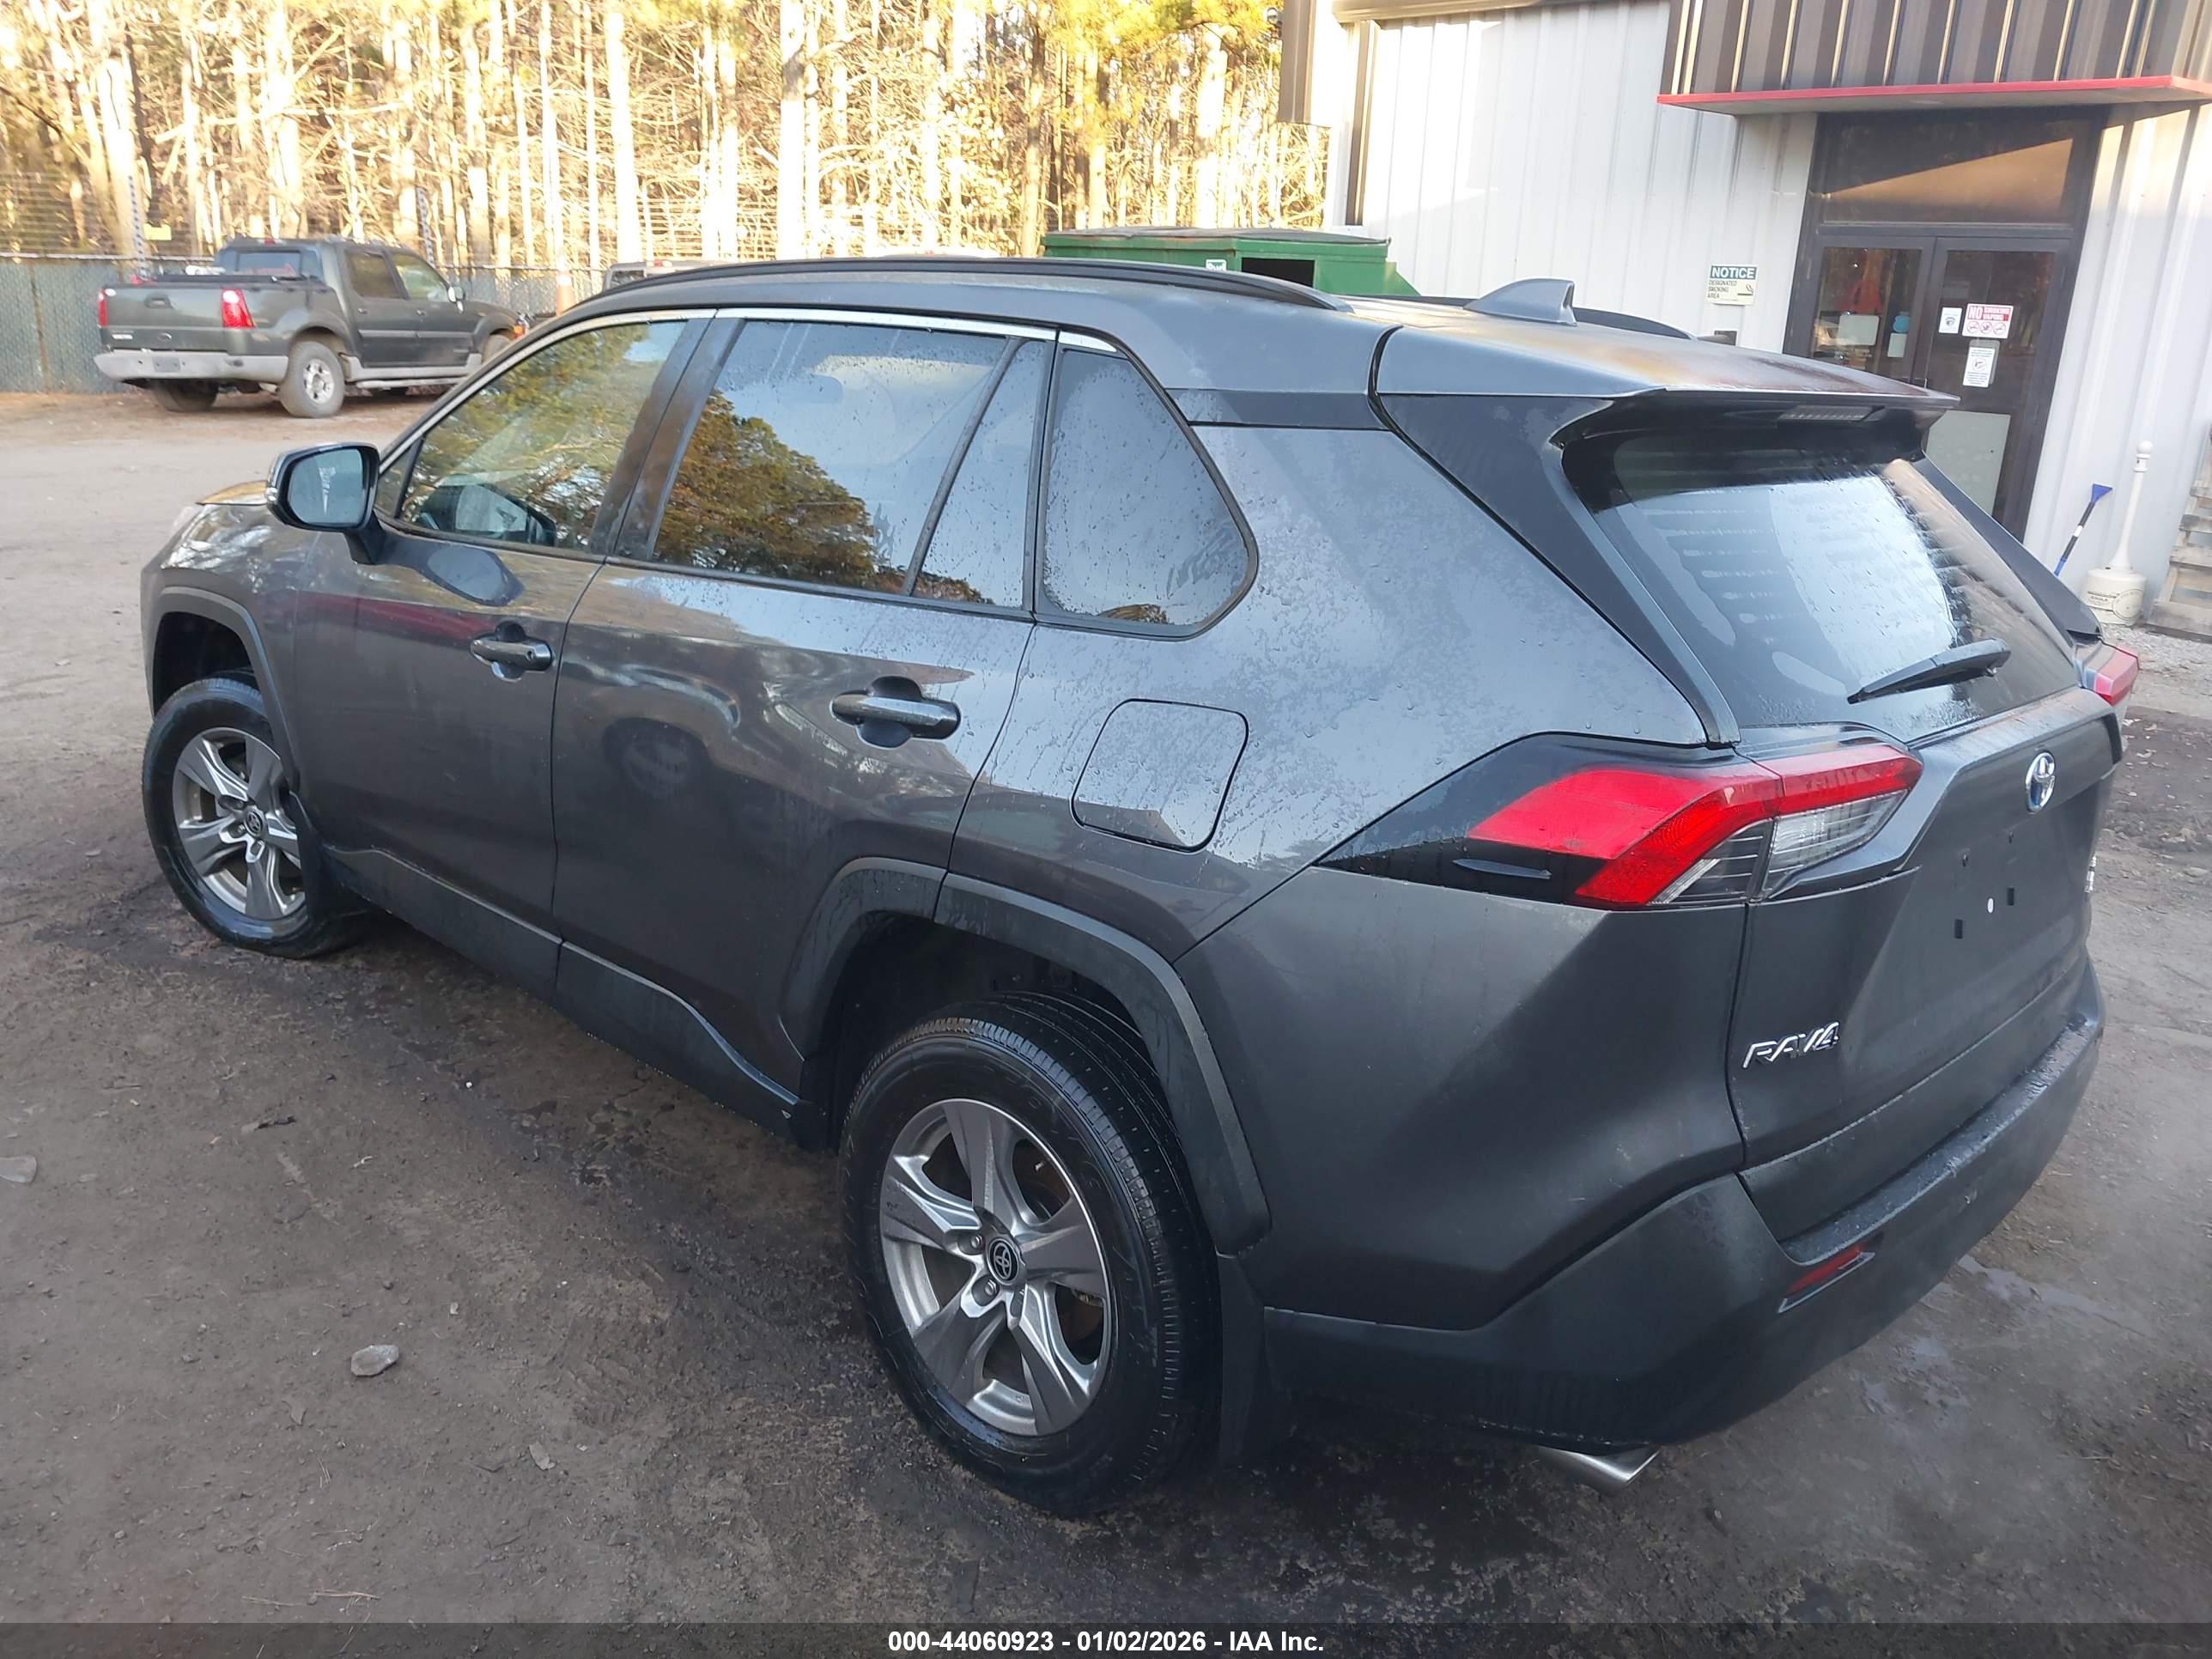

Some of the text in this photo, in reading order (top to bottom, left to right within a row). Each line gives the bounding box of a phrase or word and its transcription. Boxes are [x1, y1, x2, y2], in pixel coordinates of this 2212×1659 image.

[1711, 267, 1755, 279] NOTICE
[1969, 306, 1983, 319] NO
[1741, 1021, 1839, 1069] RAV4
